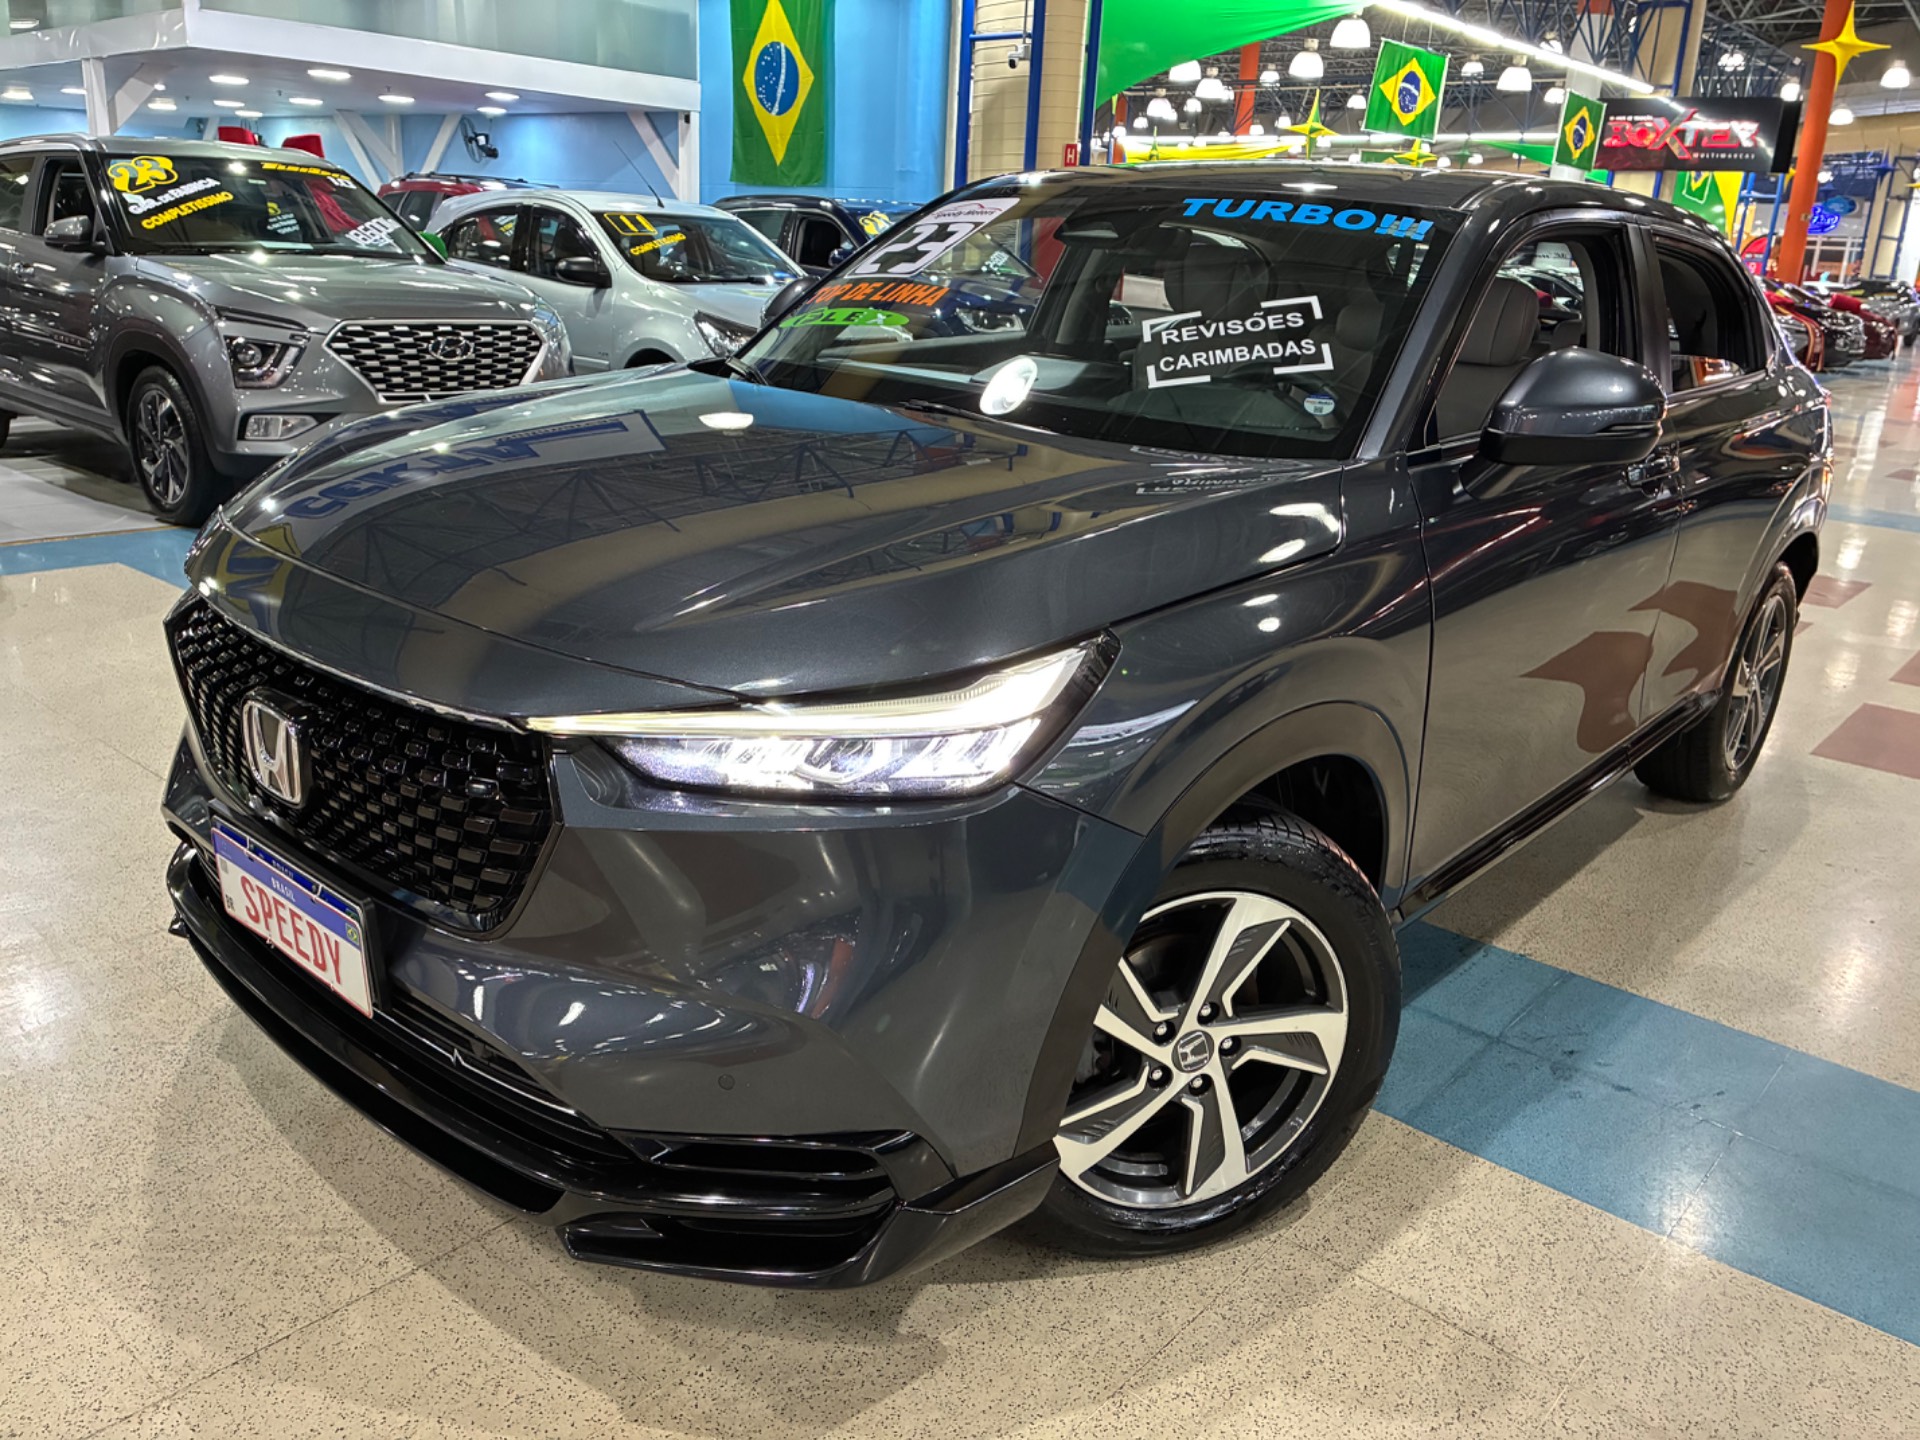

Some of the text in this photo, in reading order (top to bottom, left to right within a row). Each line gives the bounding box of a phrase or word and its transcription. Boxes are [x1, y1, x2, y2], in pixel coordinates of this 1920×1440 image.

[1603, 108, 1760, 160] BOXTER
[1066, 148, 1075, 163] H
[107, 155, 179, 194] 23
[619, 214, 656, 233] 11
[1183, 198, 1435, 241] TURBO!!!
[846, 221, 978, 275] 23
[849, 282, 880, 299] DE
[874, 281, 951, 307] LINHA
[1161, 311, 1304, 345] REVISÕES
[1159, 339, 1316, 372] CARIMBADAS
[271, 877, 296, 903] BRASIL
[240, 875, 341, 985] SPEEDY
